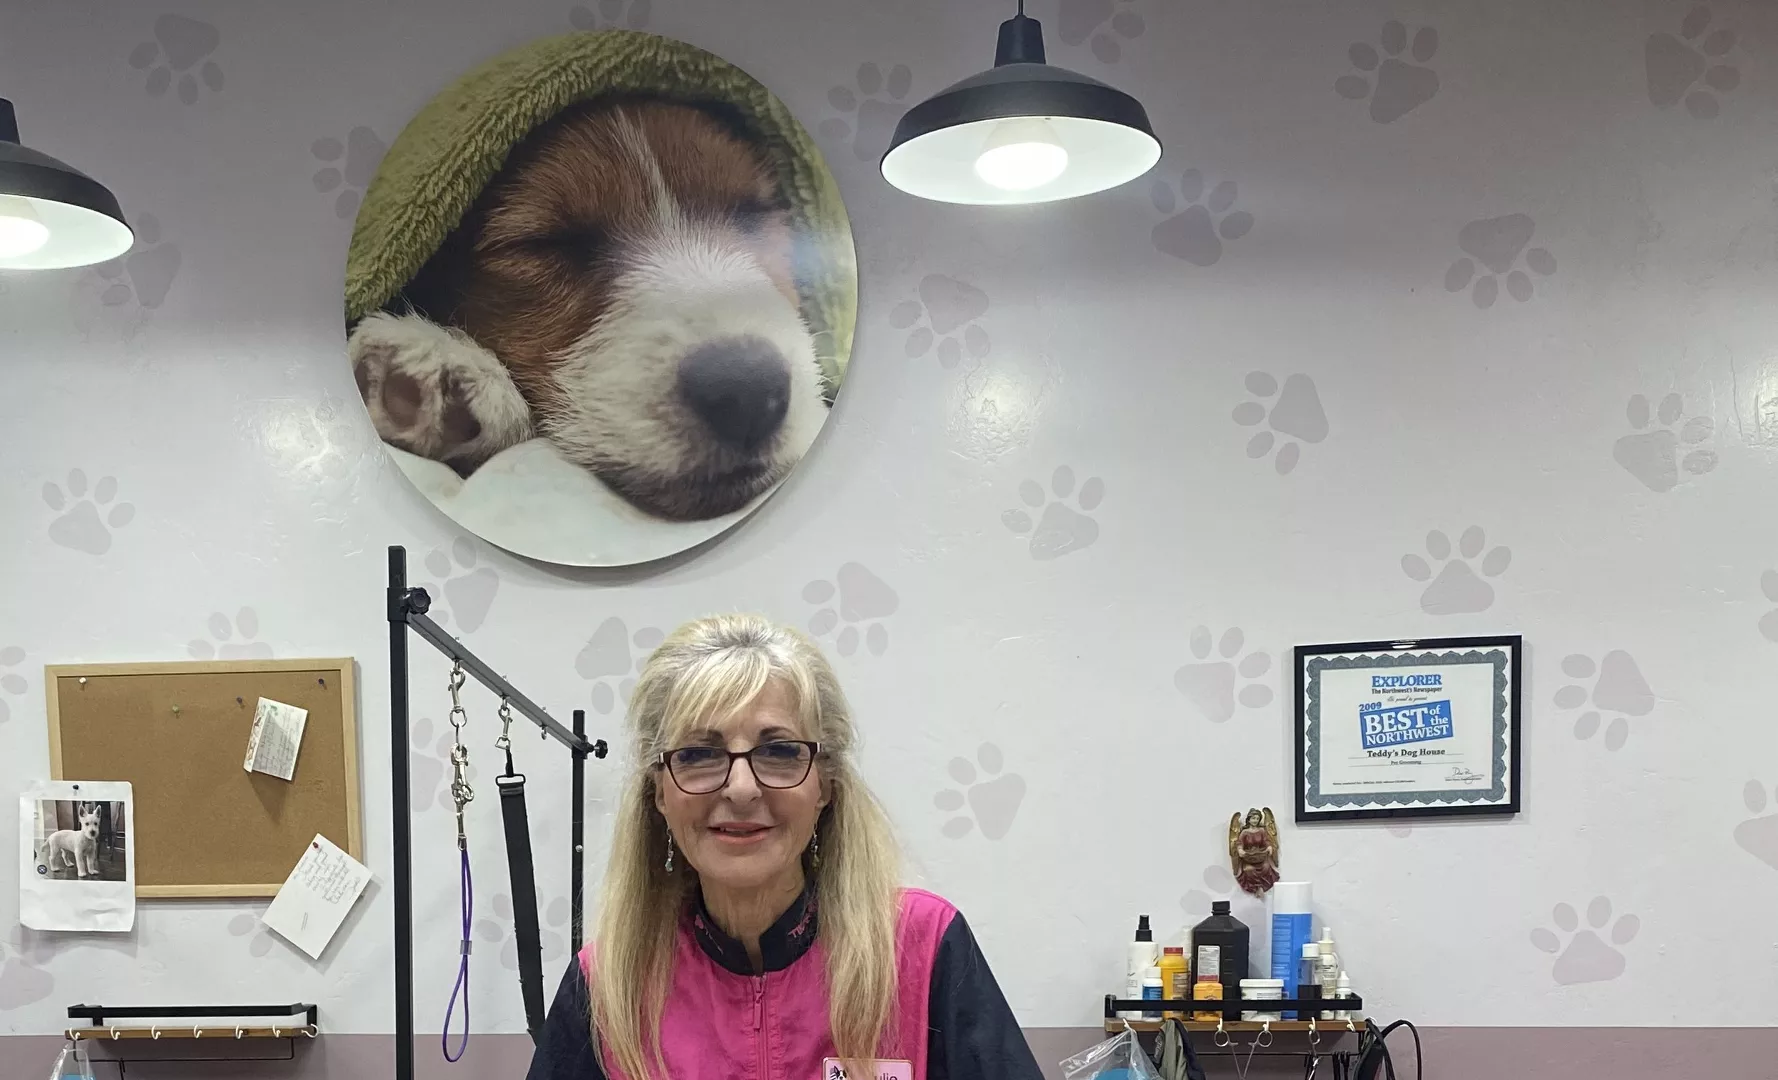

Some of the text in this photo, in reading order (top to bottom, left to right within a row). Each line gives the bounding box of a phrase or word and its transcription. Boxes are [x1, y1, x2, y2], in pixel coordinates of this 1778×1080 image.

[1372, 674, 1442, 687] EXPLORER
[1359, 702, 1382, 711] 2009
[1364, 704, 1441, 735] BEST of
[1430, 715, 1448, 726] the
[1366, 725, 1449, 746] NORTHWEST
[1367, 748, 1445, 758] Teddy's Dog House
